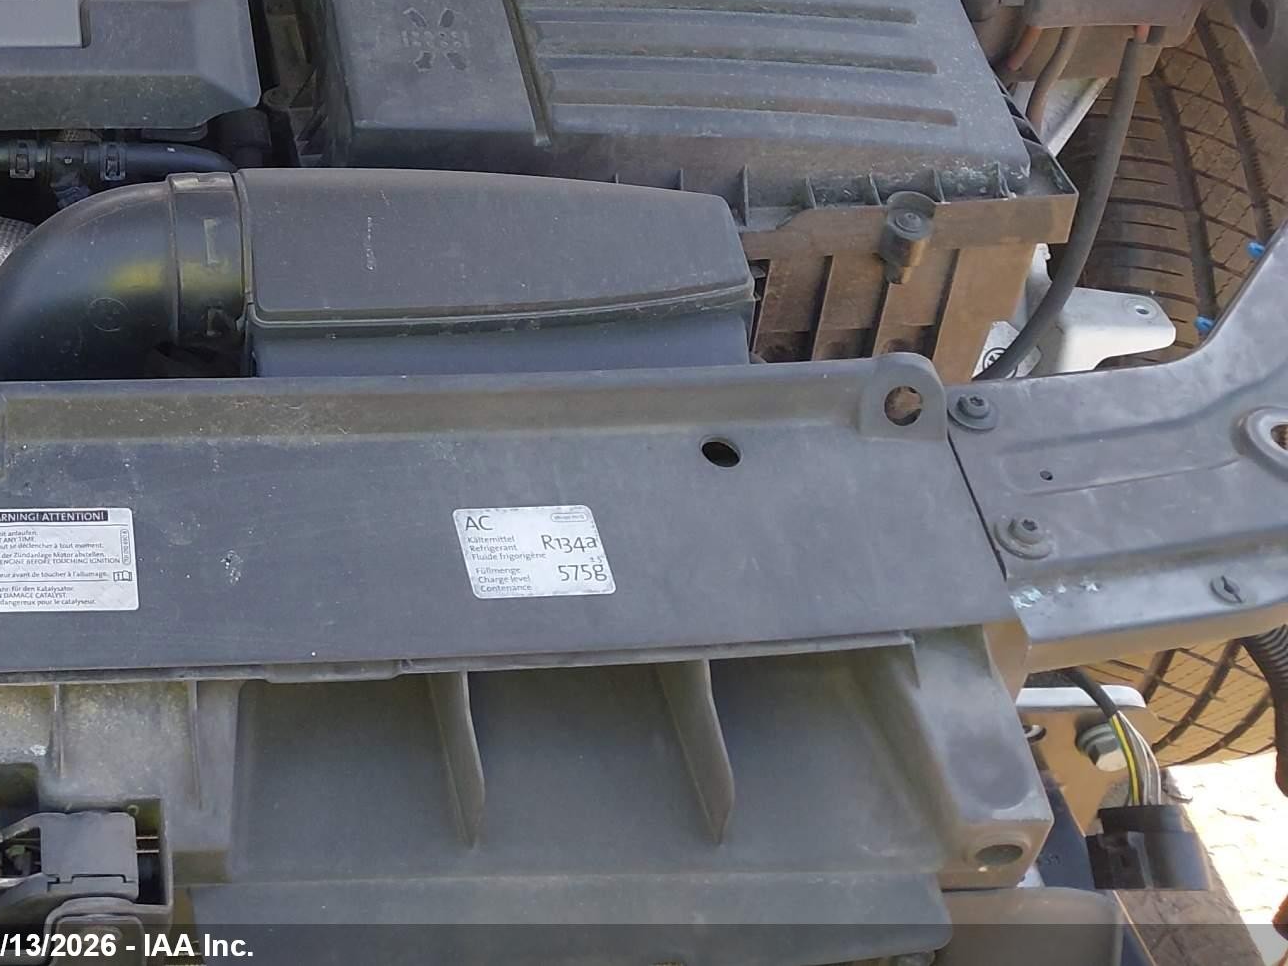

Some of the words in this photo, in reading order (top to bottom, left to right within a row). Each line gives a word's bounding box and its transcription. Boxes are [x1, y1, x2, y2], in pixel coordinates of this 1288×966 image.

[41, 511, 105, 522] ATTENTION!
[465, 515, 493, 531] AC
[469, 544, 518, 553] Refrigerant
[540, 534, 598, 553] R134a
[558, 564, 607, 582] 575g
[478, 575, 511, 584] Charge
[512, 575, 531, 583] level
[480, 584, 533, 593] Contenance
